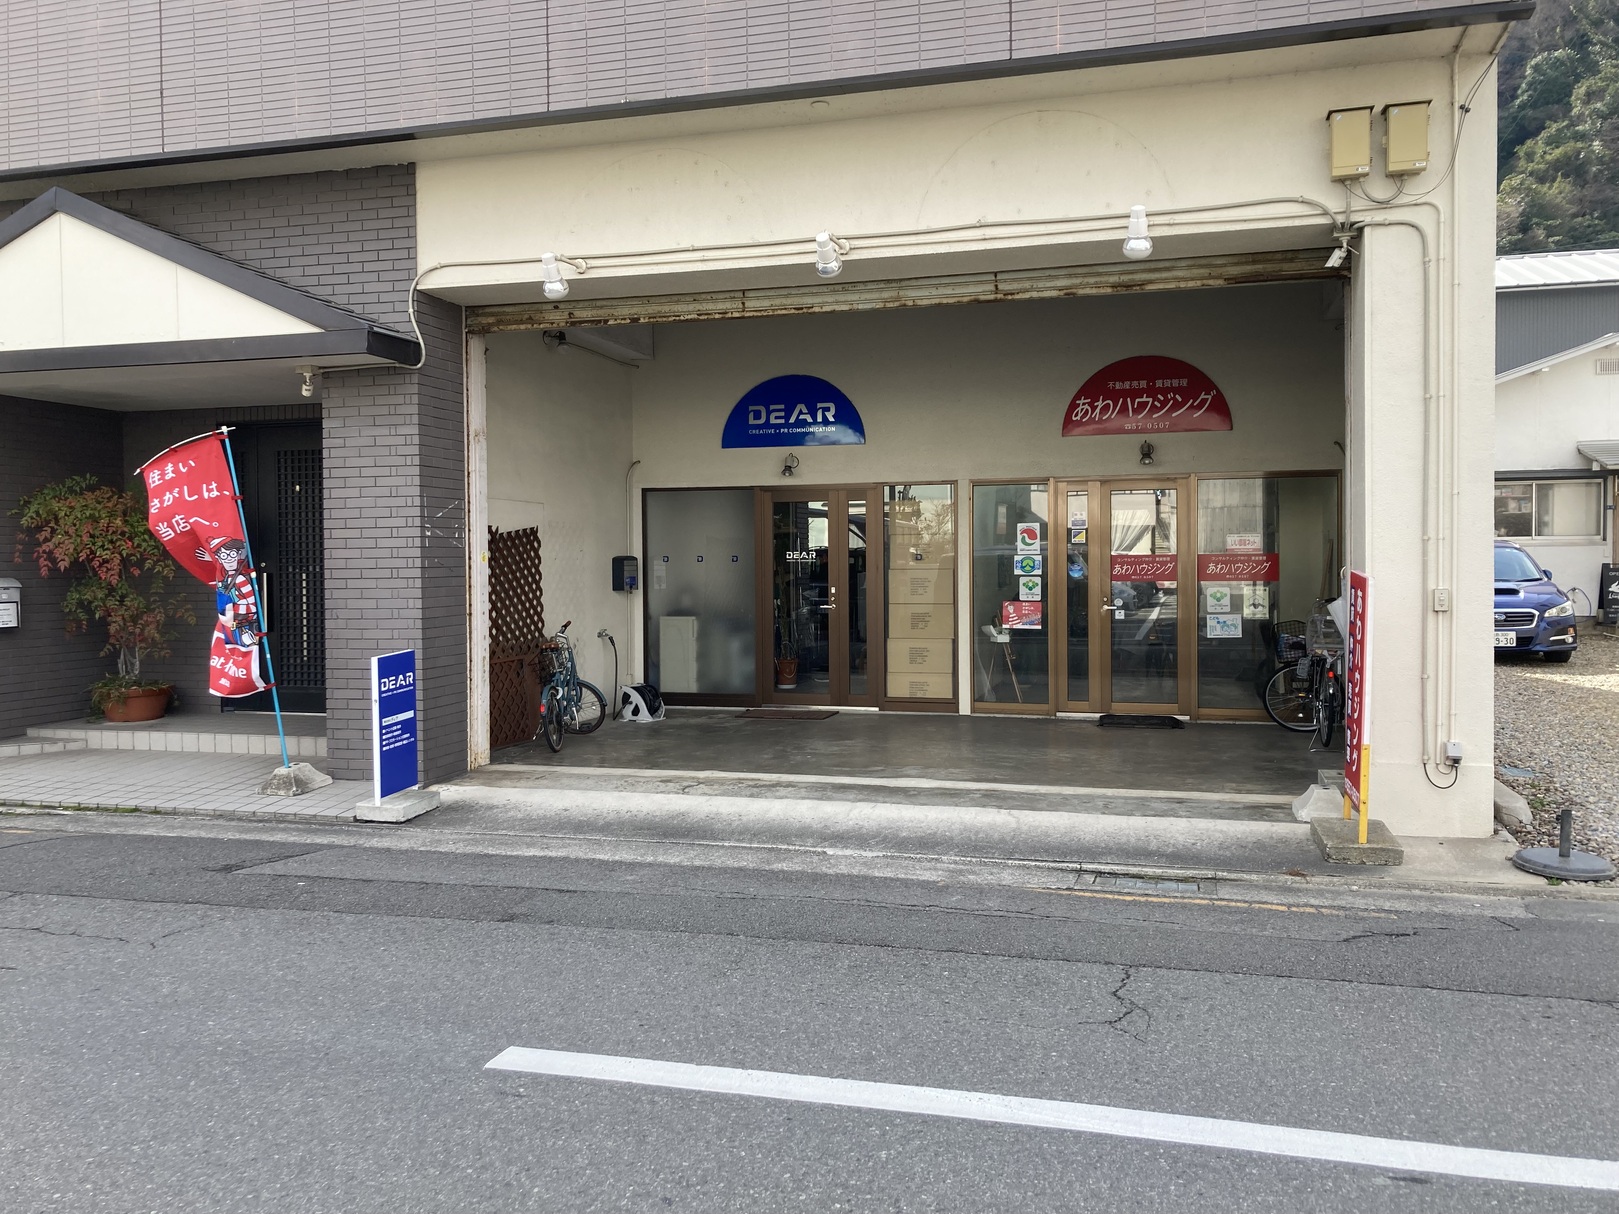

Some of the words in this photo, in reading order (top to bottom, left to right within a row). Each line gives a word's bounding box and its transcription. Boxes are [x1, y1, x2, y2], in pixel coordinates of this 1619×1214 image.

[748, 402, 836, 425] DEAR
[1071, 389, 1217, 422] あわハウジング
[148, 459, 196, 489] 住まい
[150, 480, 230, 514] さがしは、
[155, 513, 219, 541] 当店へ。
[786, 551, 816, 559] DEAR
[1112, 561, 1175, 575] あわハウジング
[1206, 561, 1272, 575] あわハウジング
[210, 655, 226, 669] at
[380, 671, 414, 692] DEAR
[1352, 588, 1363, 772] あわハウジング
